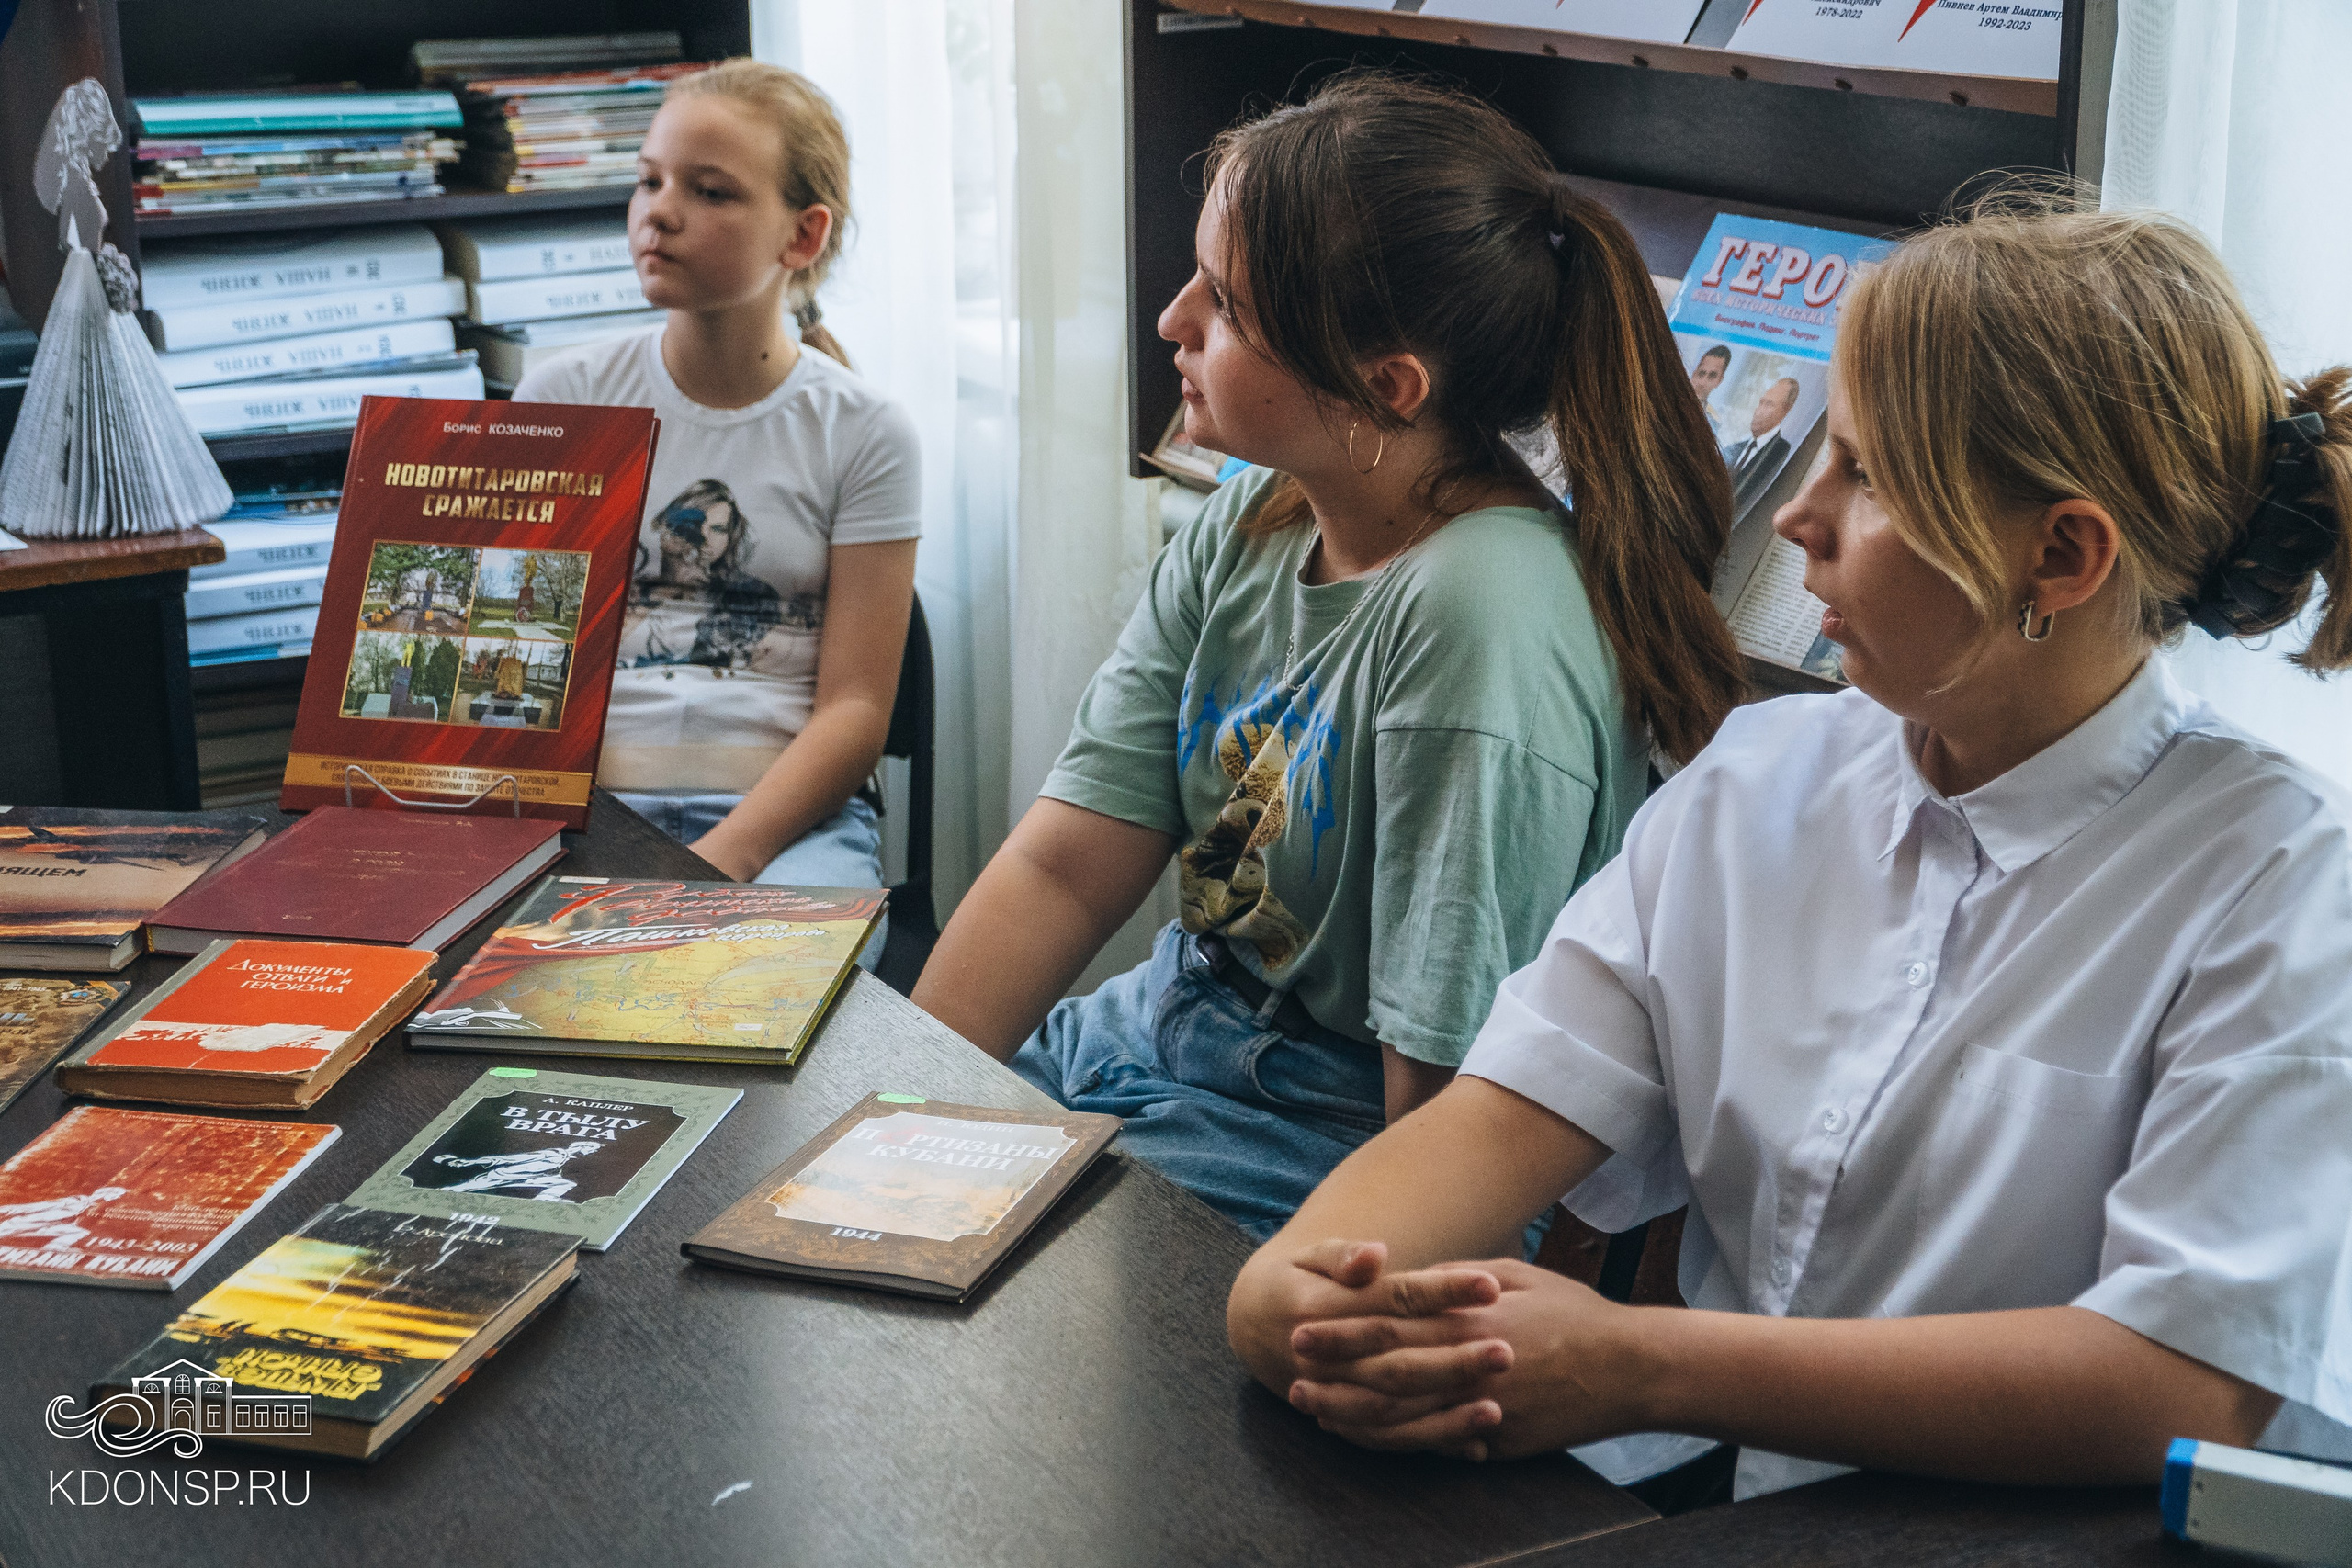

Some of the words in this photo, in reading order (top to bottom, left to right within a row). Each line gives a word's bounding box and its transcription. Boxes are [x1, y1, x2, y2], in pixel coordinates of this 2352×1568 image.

[1815, 6, 1863, 18] 1978-2022
[1977, 5, 2009, 15] Артем
[1978, 17, 2031, 31] 1992-2023
[1702, 236, 1847, 309] ГЕРО
[488, 423, 564, 438] КОЗАЧЕНКО
[384, 462, 605, 497] НОВОТИТАРОВСКАЯ
[422, 494, 556, 524] СРАЖАЕТСЯ
[542, 1097, 560, 1105] А.
[564, 1099, 635, 1112] КАПЛЕР
[499, 1106, 529, 1118] В
[536, 1109, 652, 1131] ТЫЛУ
[504, 1118, 618, 1142] ВРАГА
[865, 1144, 1015, 1172] КУБАНИ
[449, 1213, 501, 1225] 1942
[829, 1227, 883, 1242] 1944
